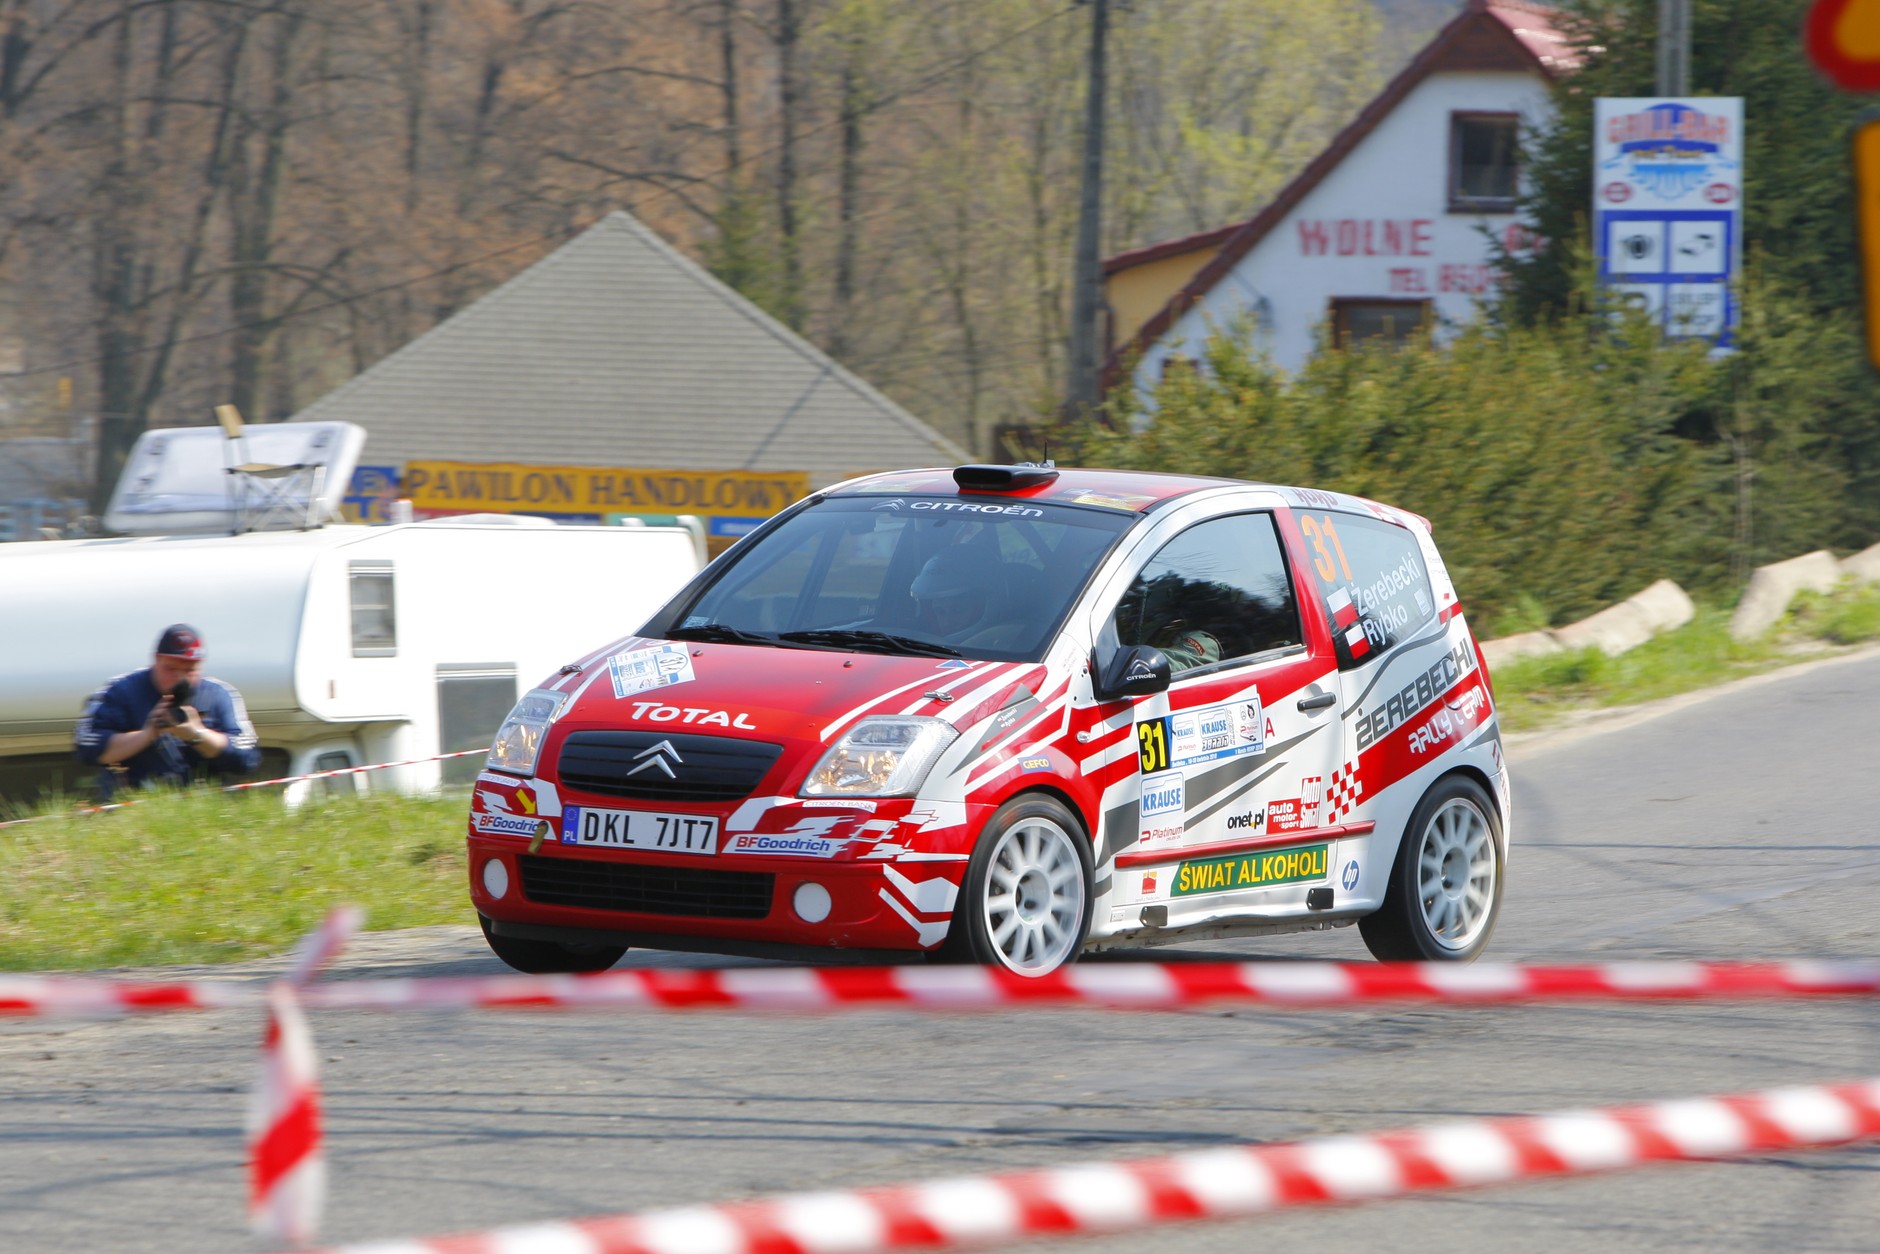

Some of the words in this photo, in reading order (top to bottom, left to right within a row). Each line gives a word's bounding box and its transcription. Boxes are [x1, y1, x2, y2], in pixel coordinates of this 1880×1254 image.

[1297, 219, 1433, 256] WOLNE
[407, 468, 578, 503] PAWILON
[588, 474, 804, 510] HANDLOWY
[1301, 514, 1353, 583] 31
[1350, 552, 1421, 617] Żerebecki
[1362, 604, 1408, 647] Rybko
[631, 700, 757, 731] TOTAL
[1201, 719, 1227, 735] KRAUSE
[1264, 717, 1275, 739] A
[1139, 721, 1166, 772] 31
[1022, 758, 1050, 769] GEFCO
[1143, 787, 1181, 811] KRAUSE
[1268, 802, 1294, 815] auto
[479, 815, 539, 832] BFGoodric
[1227, 808, 1265, 830] onet.pl
[1273, 813, 1298, 823] motor
[1280, 821, 1300, 830] sport
[563, 830, 577, 842] PL
[583, 812, 635, 845] DKL
[656, 817, 714, 850] 7JT7
[1152, 826, 1183, 840] Platinum
[735, 836, 831, 852] BFGoodrich
[1179, 861, 1236, 892] ŚWIAT
[1237, 850, 1327, 885] ALKOHOLI
[1343, 859, 1358, 892] hp
